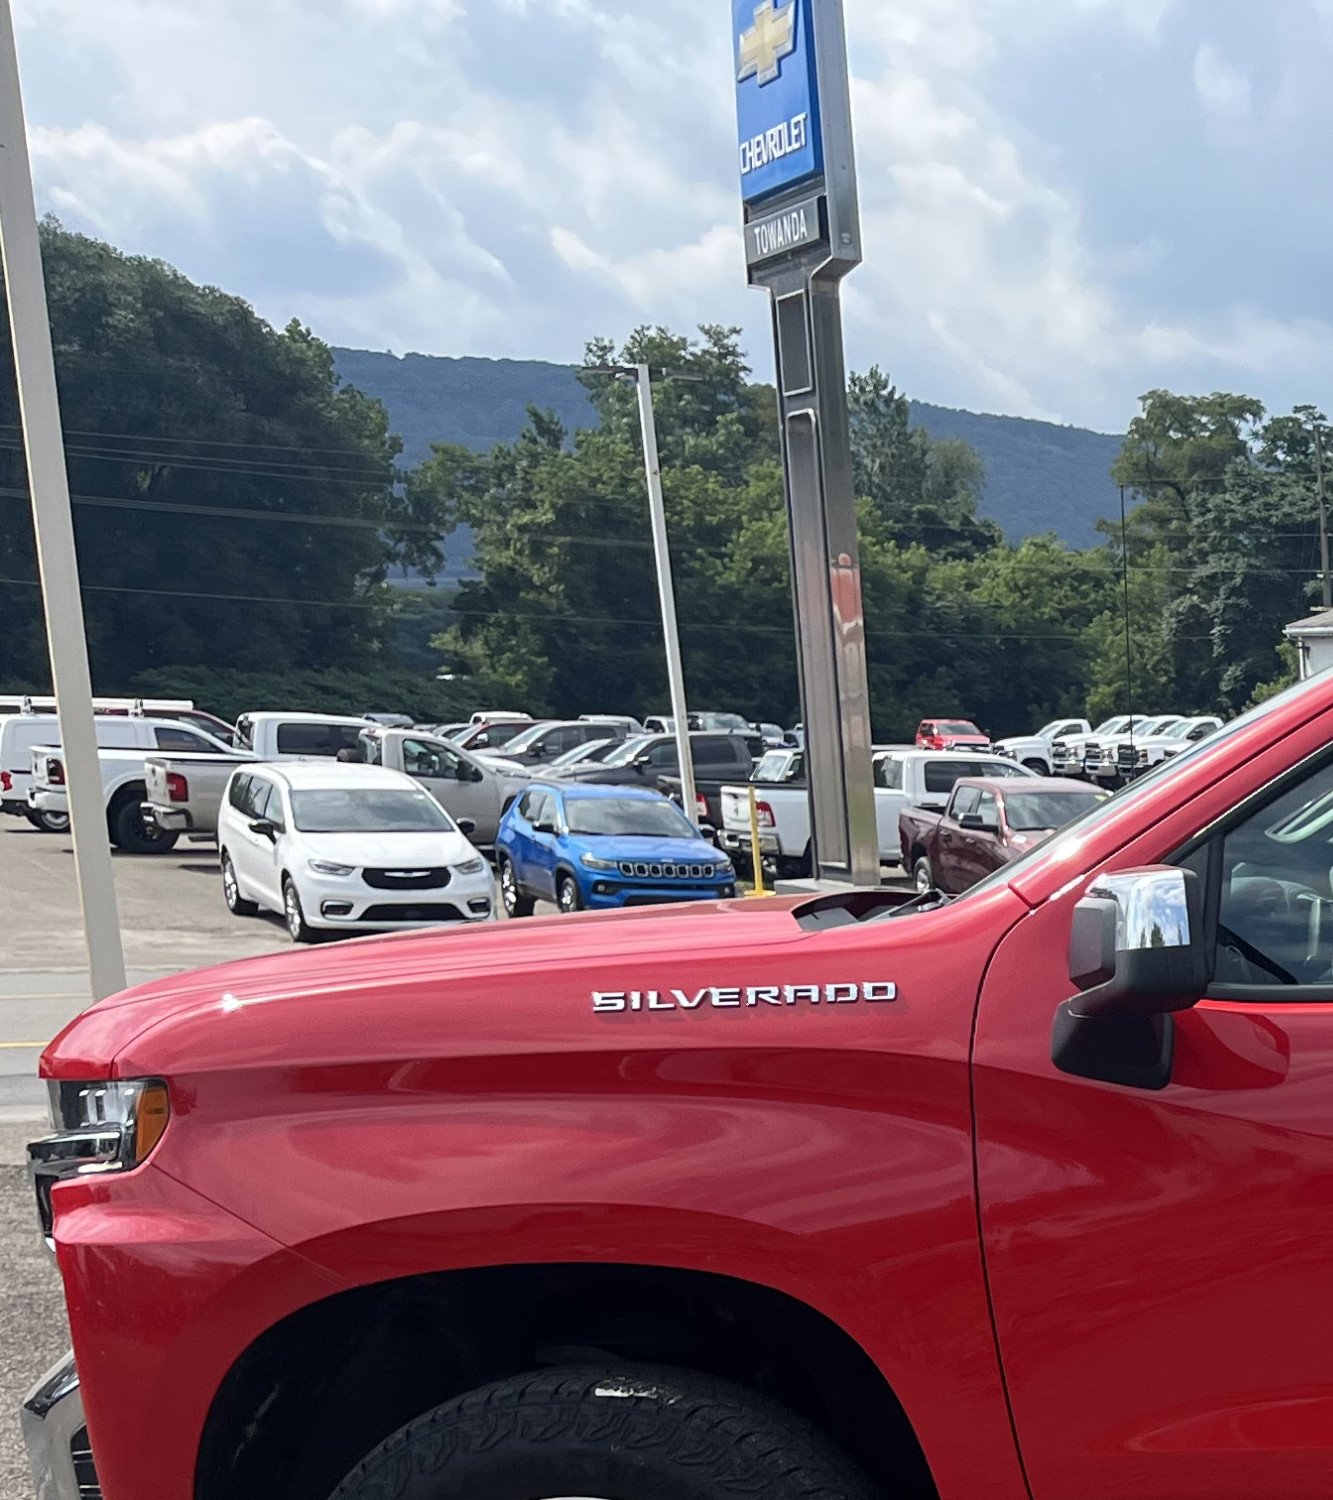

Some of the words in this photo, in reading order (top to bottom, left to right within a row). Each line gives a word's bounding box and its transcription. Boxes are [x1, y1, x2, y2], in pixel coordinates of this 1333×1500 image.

[740, 112, 807, 174] CHEVROLET
[754, 209, 807, 255] TOWANDA
[593, 982, 895, 1011] SILVERADO
